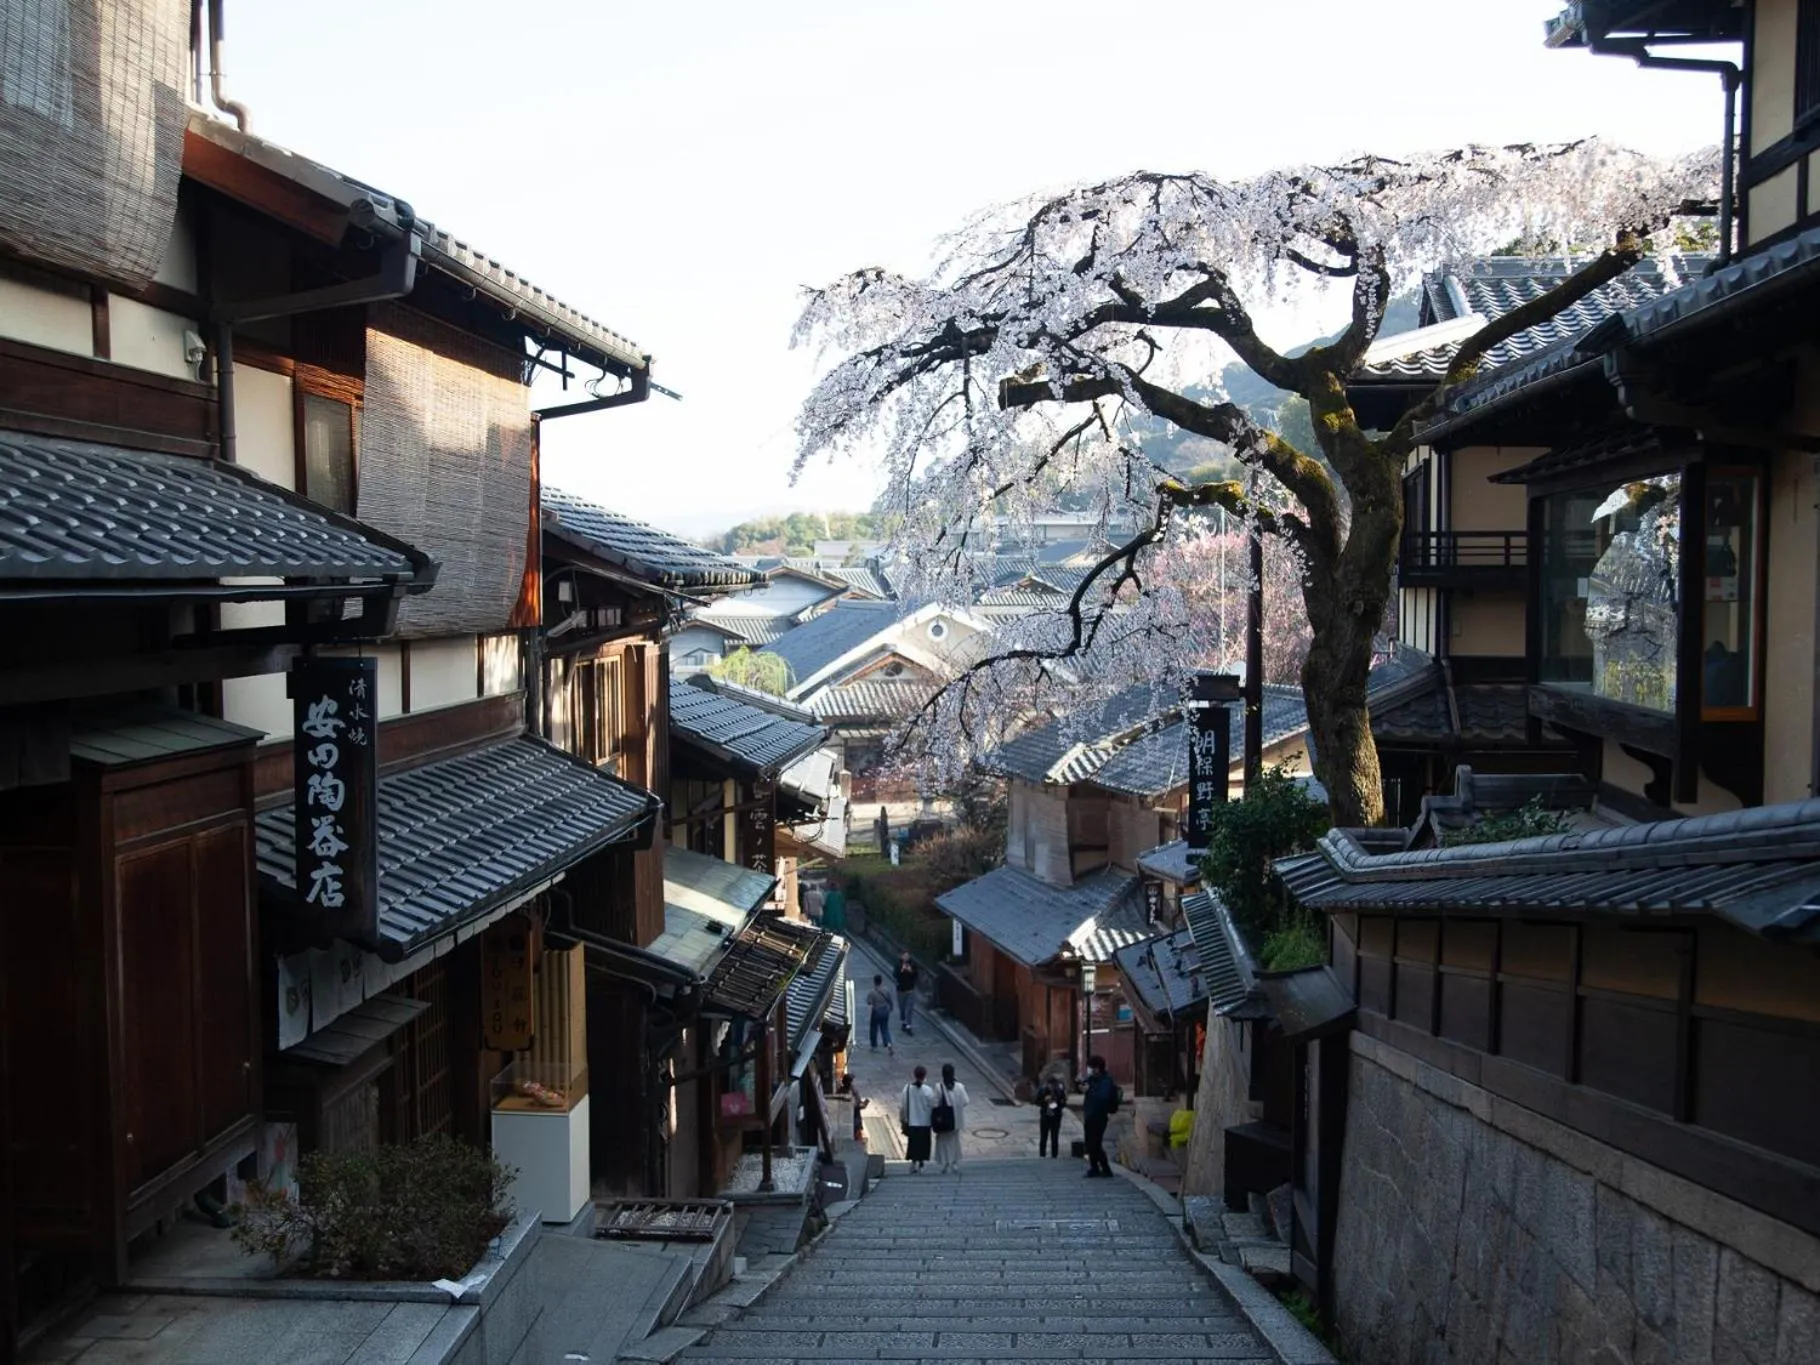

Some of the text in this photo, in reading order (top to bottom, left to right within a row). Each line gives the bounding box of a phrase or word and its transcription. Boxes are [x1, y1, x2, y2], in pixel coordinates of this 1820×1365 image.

[347, 677, 370, 746] 清水焼
[301, 693, 349, 909] 安田陶器店
[1194, 729, 1216, 832] 明保野亭
